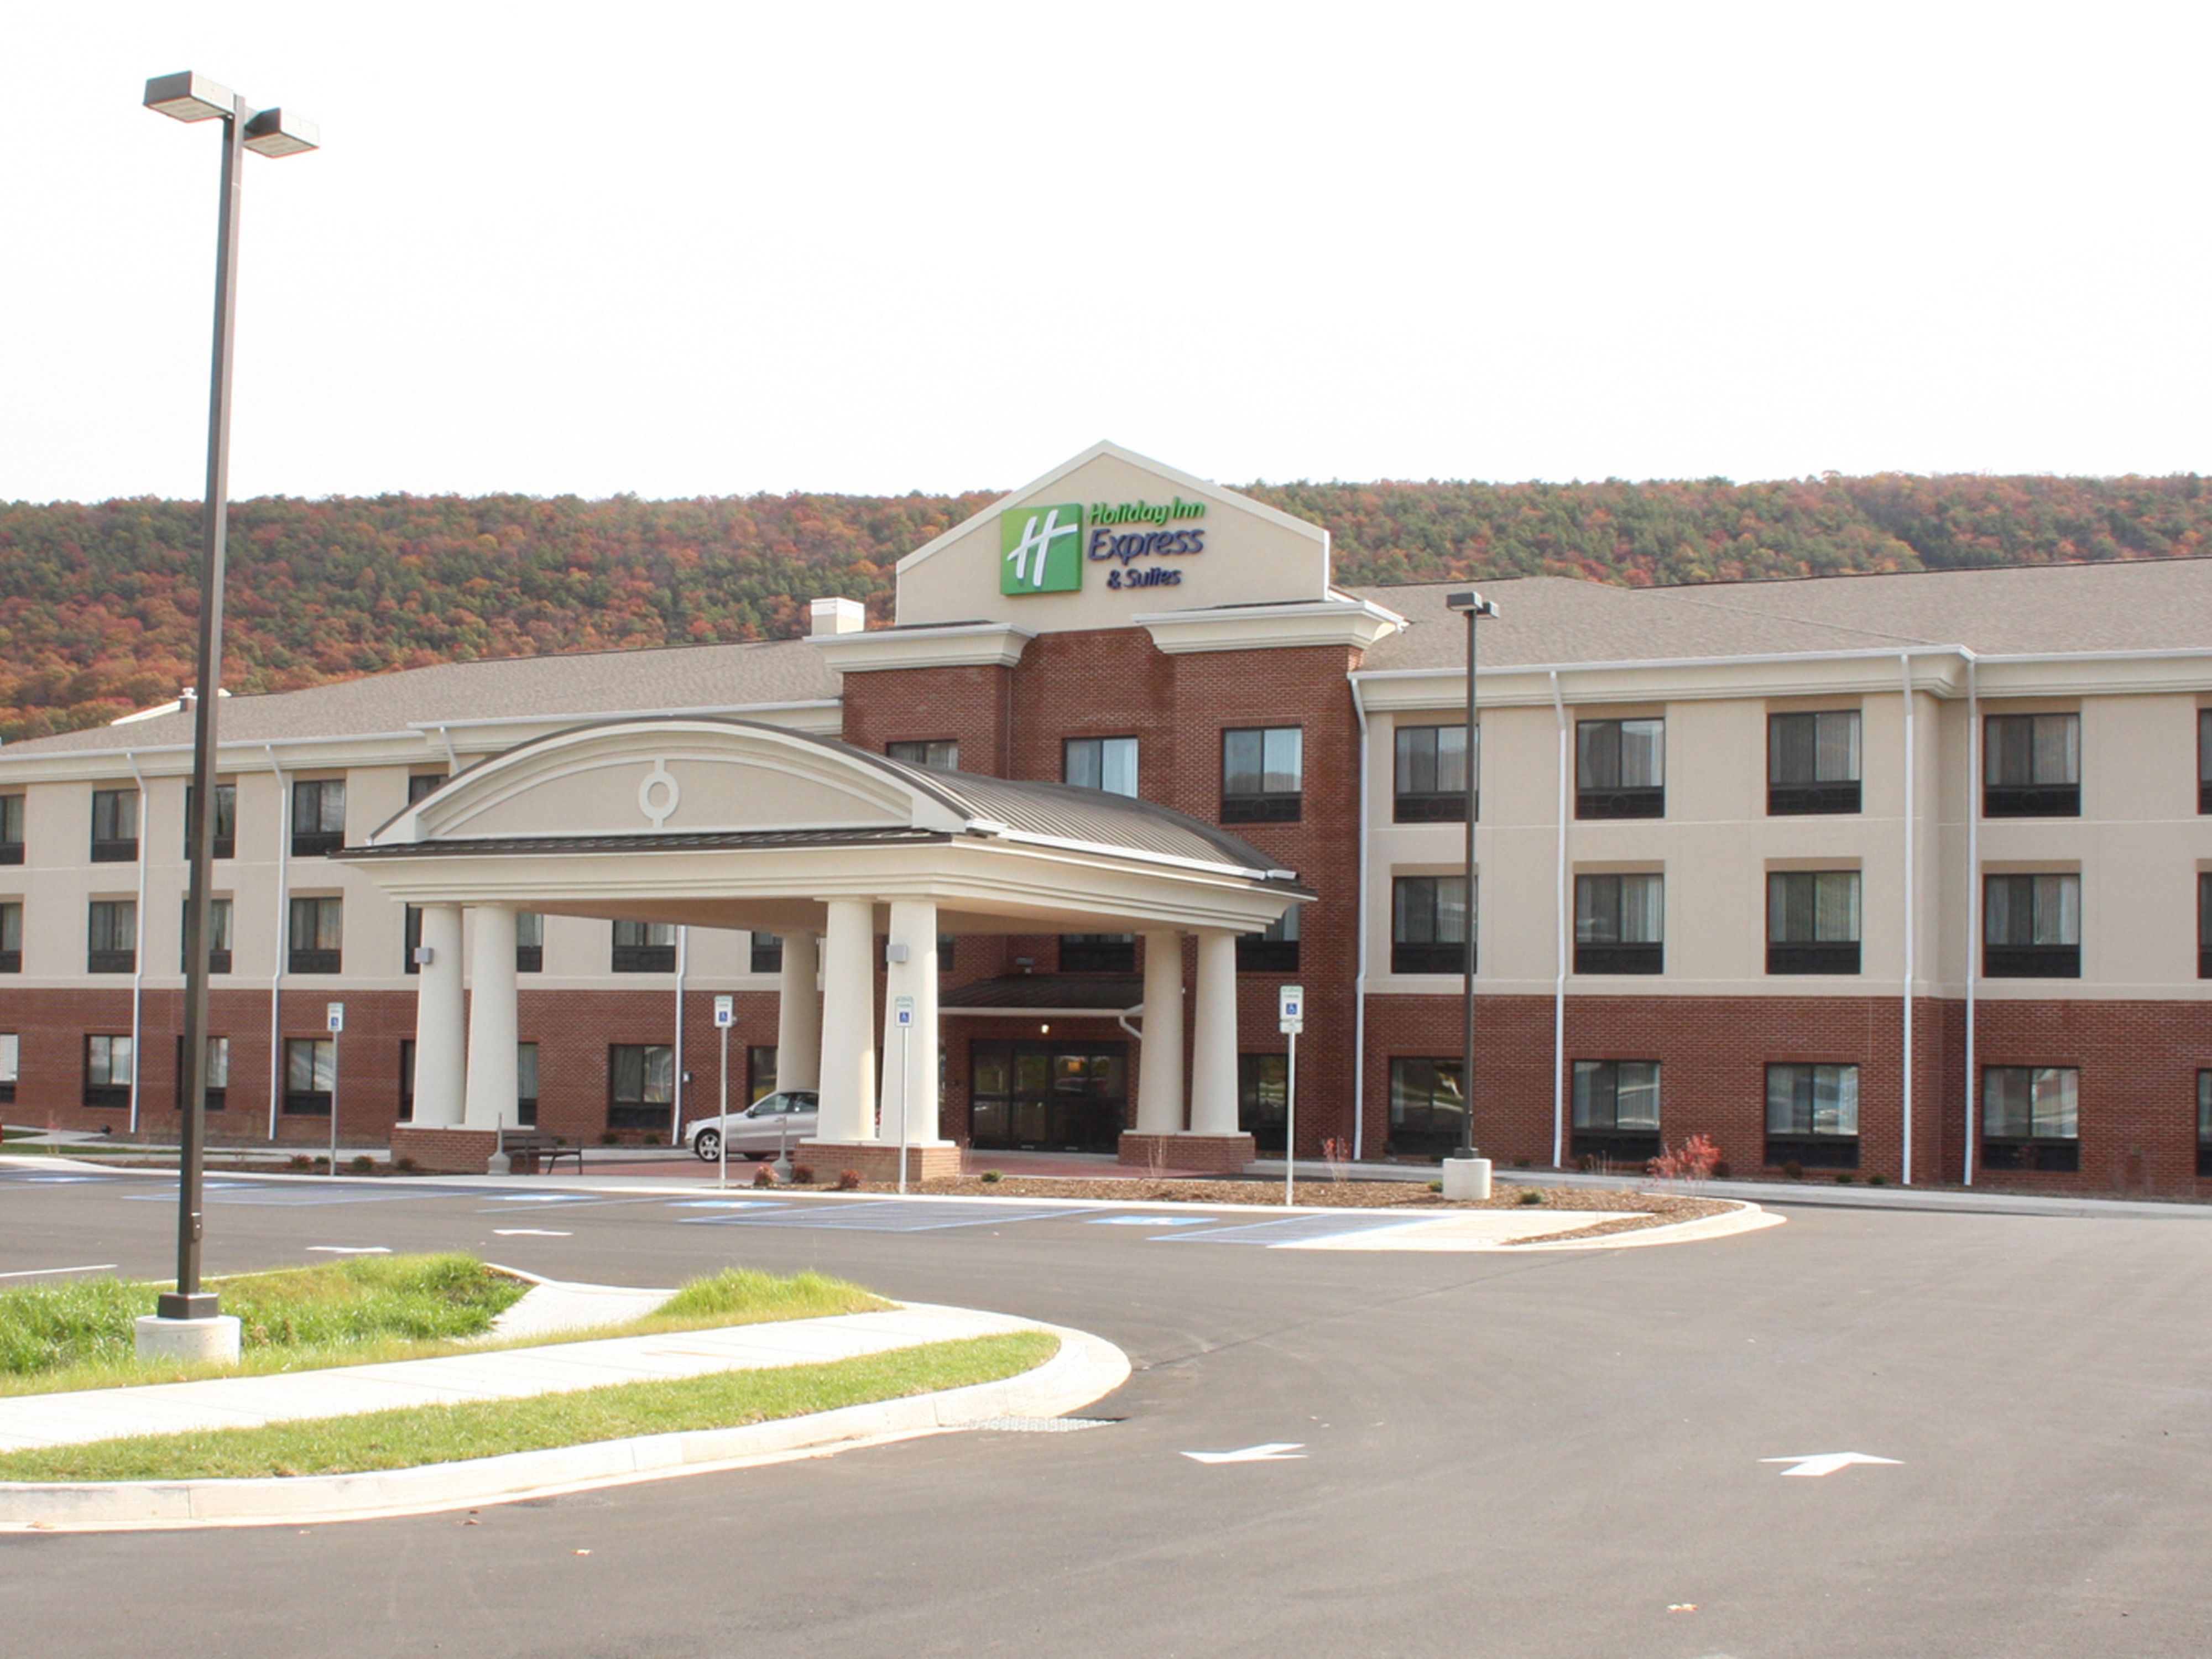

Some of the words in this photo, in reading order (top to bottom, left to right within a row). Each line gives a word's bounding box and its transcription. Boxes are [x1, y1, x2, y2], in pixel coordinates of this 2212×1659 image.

[1088, 500, 1168, 526] Holiday
[1172, 496, 1206, 519] Inn
[1088, 528, 1205, 565] Express
[1107, 569, 1121, 589] &
[1124, 567, 1182, 588] Suites
